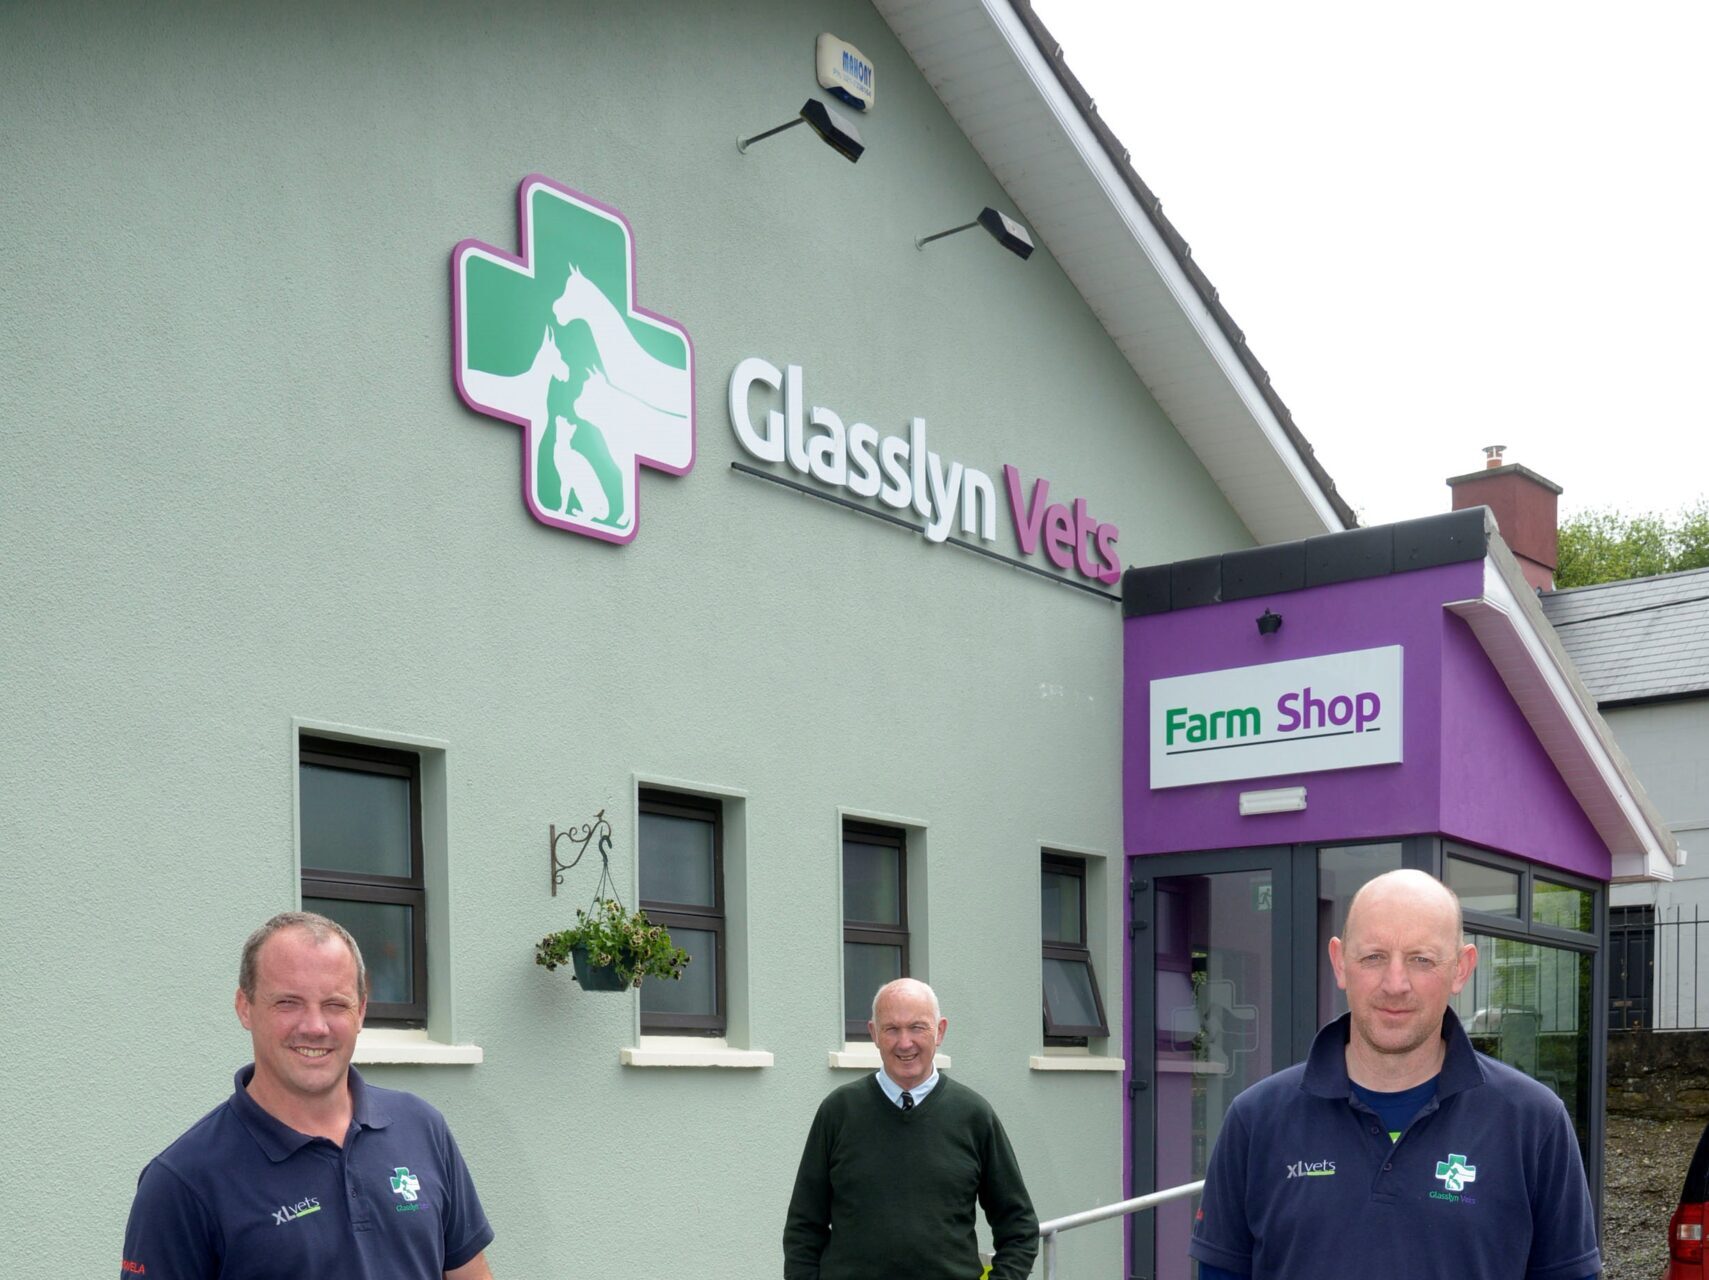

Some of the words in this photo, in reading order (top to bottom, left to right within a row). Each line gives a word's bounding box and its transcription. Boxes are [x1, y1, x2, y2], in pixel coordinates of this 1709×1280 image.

[729, 357, 996, 542] Glasslyn
[1003, 463, 1122, 585] Vets
[1166, 706, 1261, 746] Farm
[1277, 687, 1381, 733] Shop
